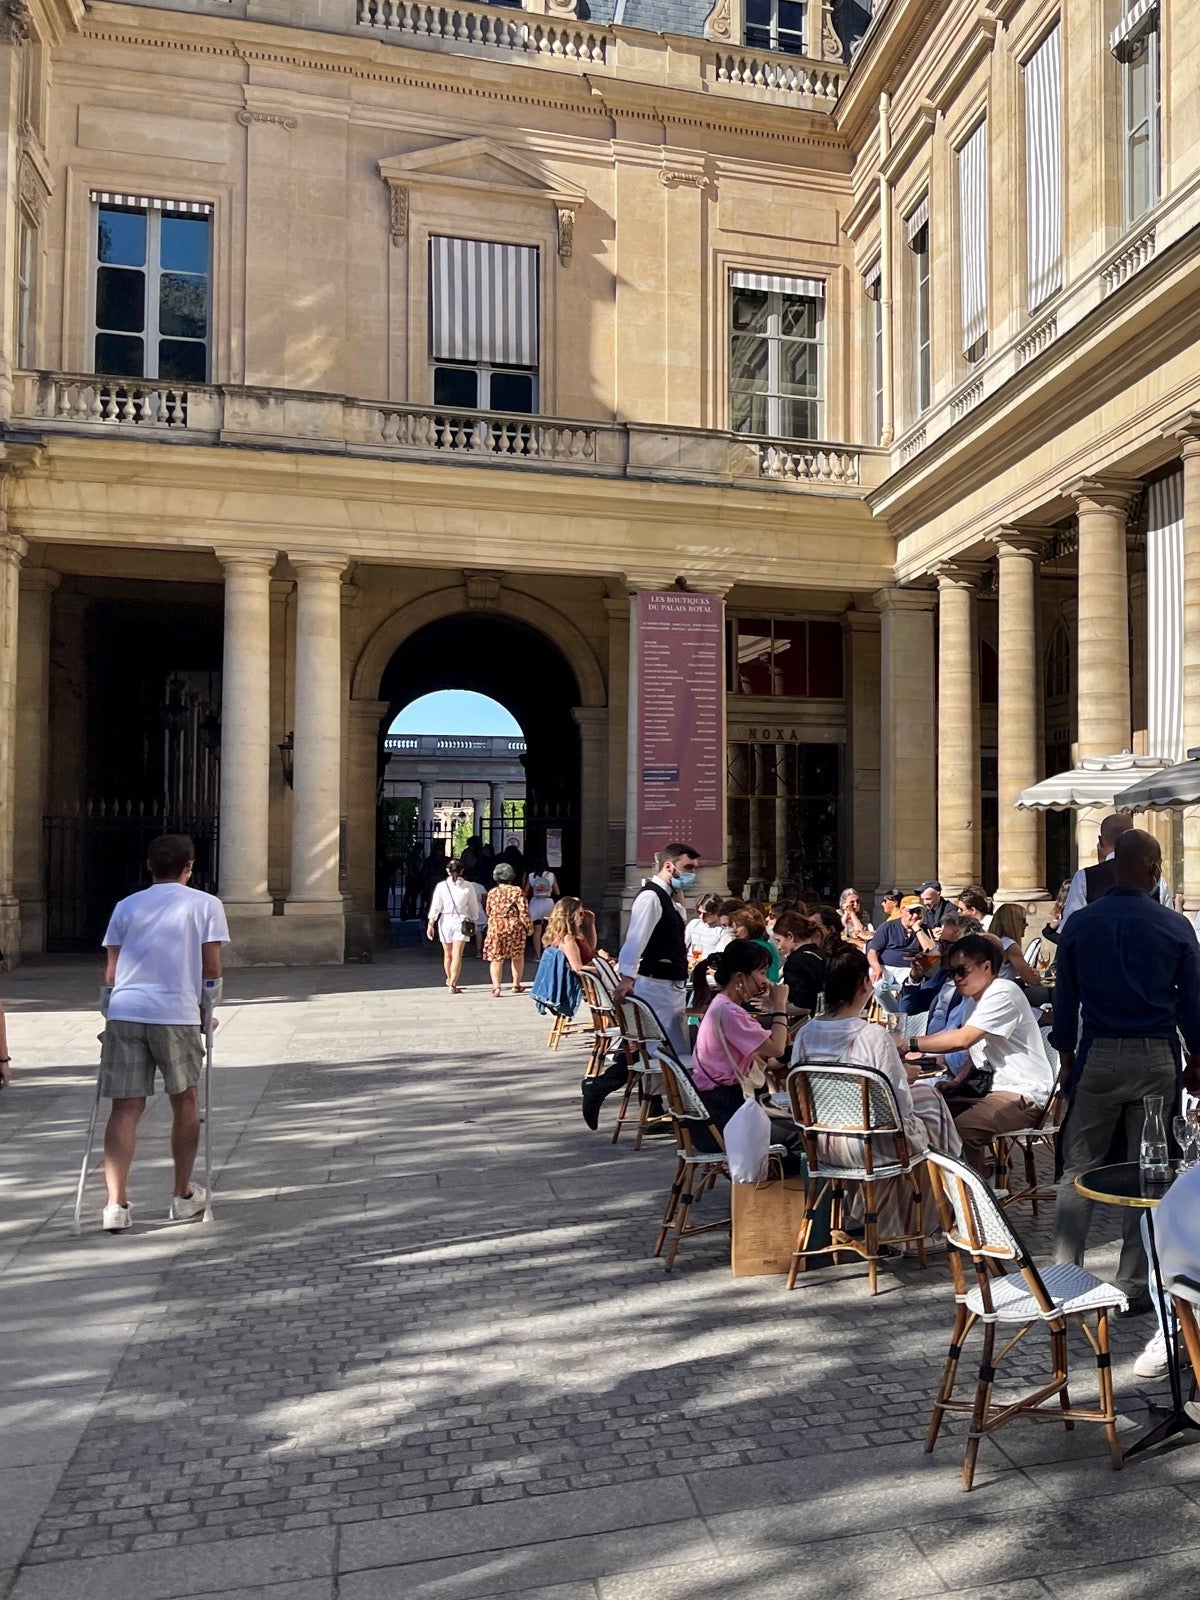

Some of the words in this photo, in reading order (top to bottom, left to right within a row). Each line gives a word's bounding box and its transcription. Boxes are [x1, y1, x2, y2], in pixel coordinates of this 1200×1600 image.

[651, 595, 665, 603] LES
[666, 596, 710, 605] BOUTIQUES
[661, 604, 687, 612] PALAIS
[748, 728, 799, 740] NOXA
